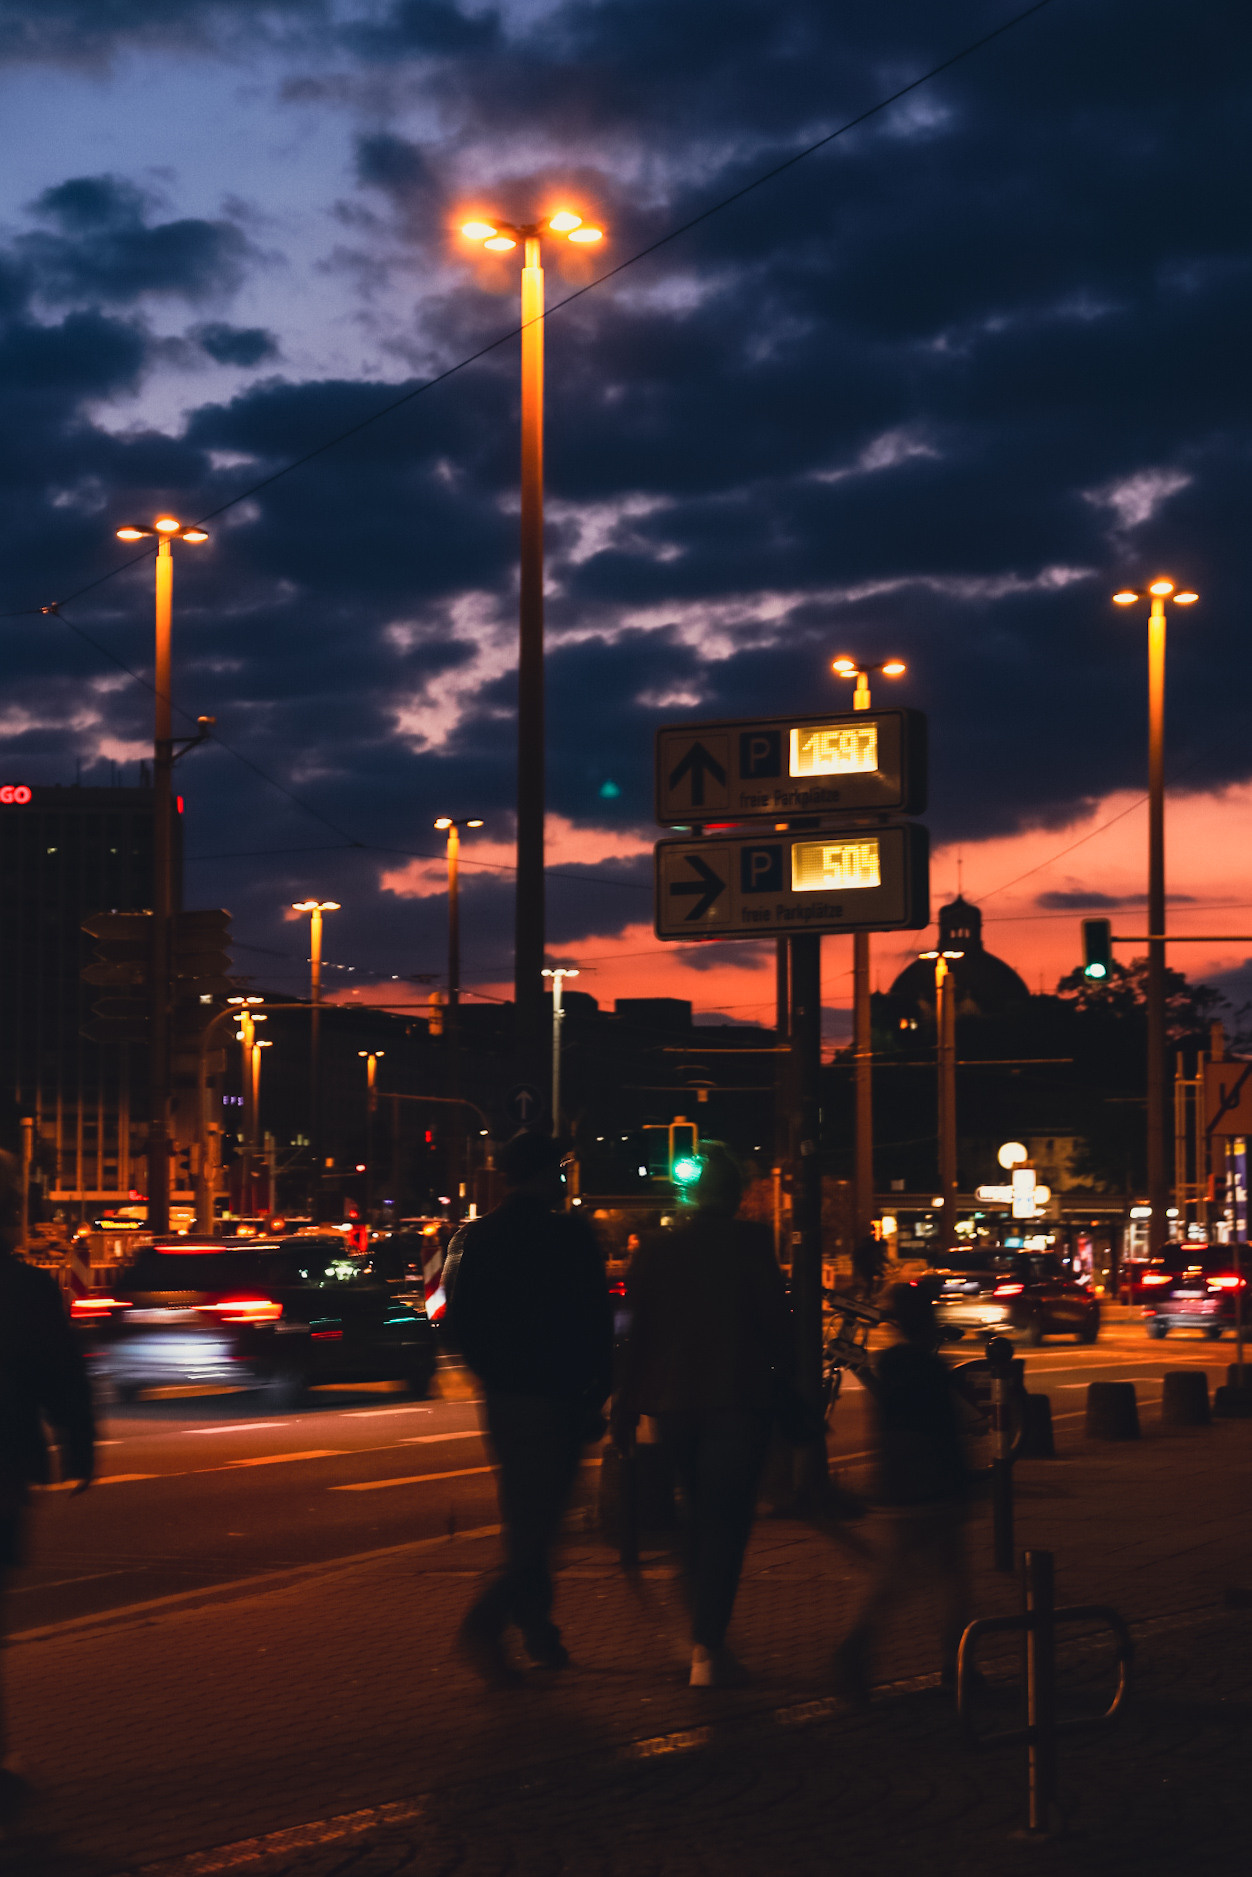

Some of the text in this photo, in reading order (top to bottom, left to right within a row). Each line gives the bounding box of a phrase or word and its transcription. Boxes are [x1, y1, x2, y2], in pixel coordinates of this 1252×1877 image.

[750, 737, 771, 773] P
[802, 729, 877, 770] 1597
[740, 787, 840, 808] freie Parkplätze
[751, 851, 773, 887] P
[742, 902, 843, 923] freie Parkplätze
